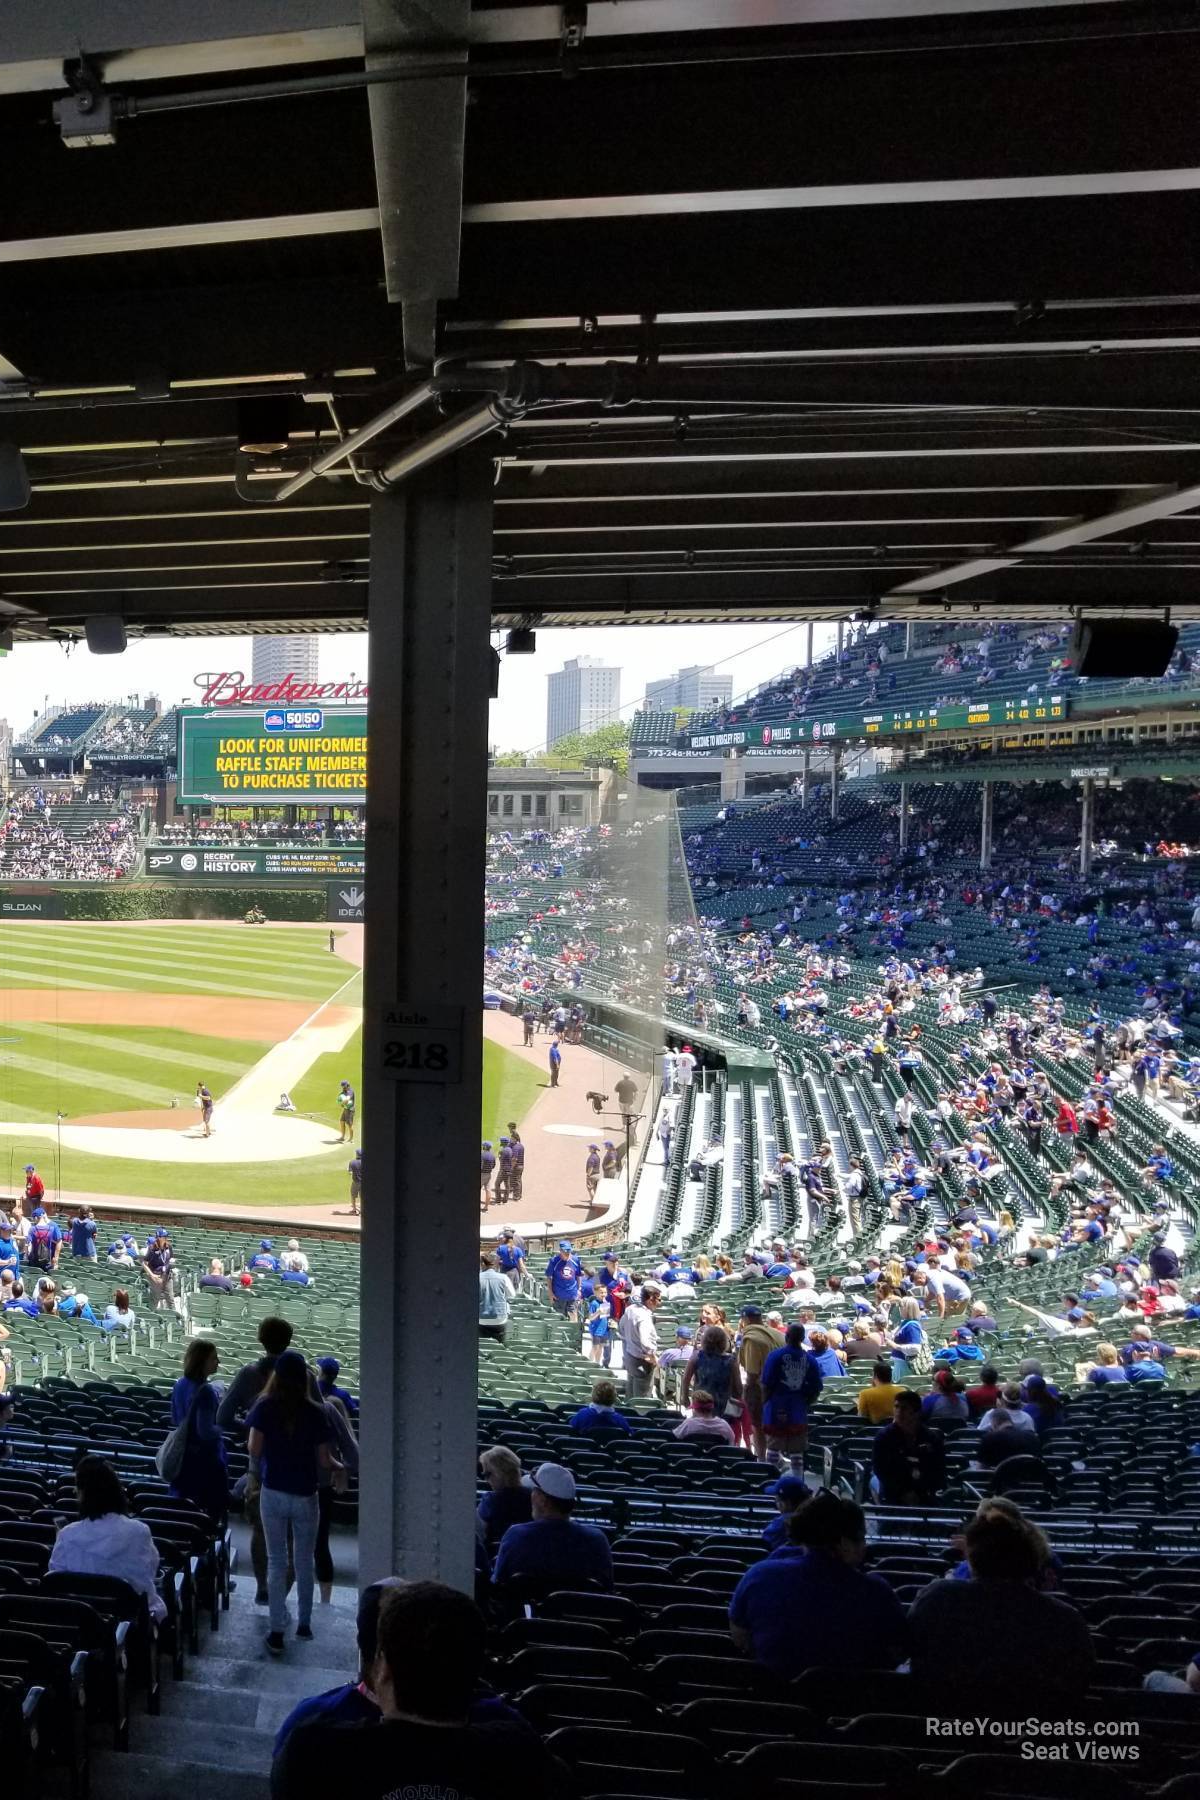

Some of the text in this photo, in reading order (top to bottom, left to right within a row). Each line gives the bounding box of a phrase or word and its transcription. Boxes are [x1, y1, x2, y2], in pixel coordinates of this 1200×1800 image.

[772, 728, 791, 740] PHILLIES
[822, 724, 835, 736] CUBS
[220, 739, 254, 754] LOOK
[260, 738, 284, 753] FOR
[692, 737, 709, 748] WELCOME
[216, 757, 261, 772] RAFFLE
[265, 757, 302, 771] STAFF
[222, 774, 367, 789] TO PURCHASE TICKETS
[204, 862, 256, 872] HISTORY
[386, 1011, 428, 1024] Aisle
[384, 1042, 448, 1072] 218
